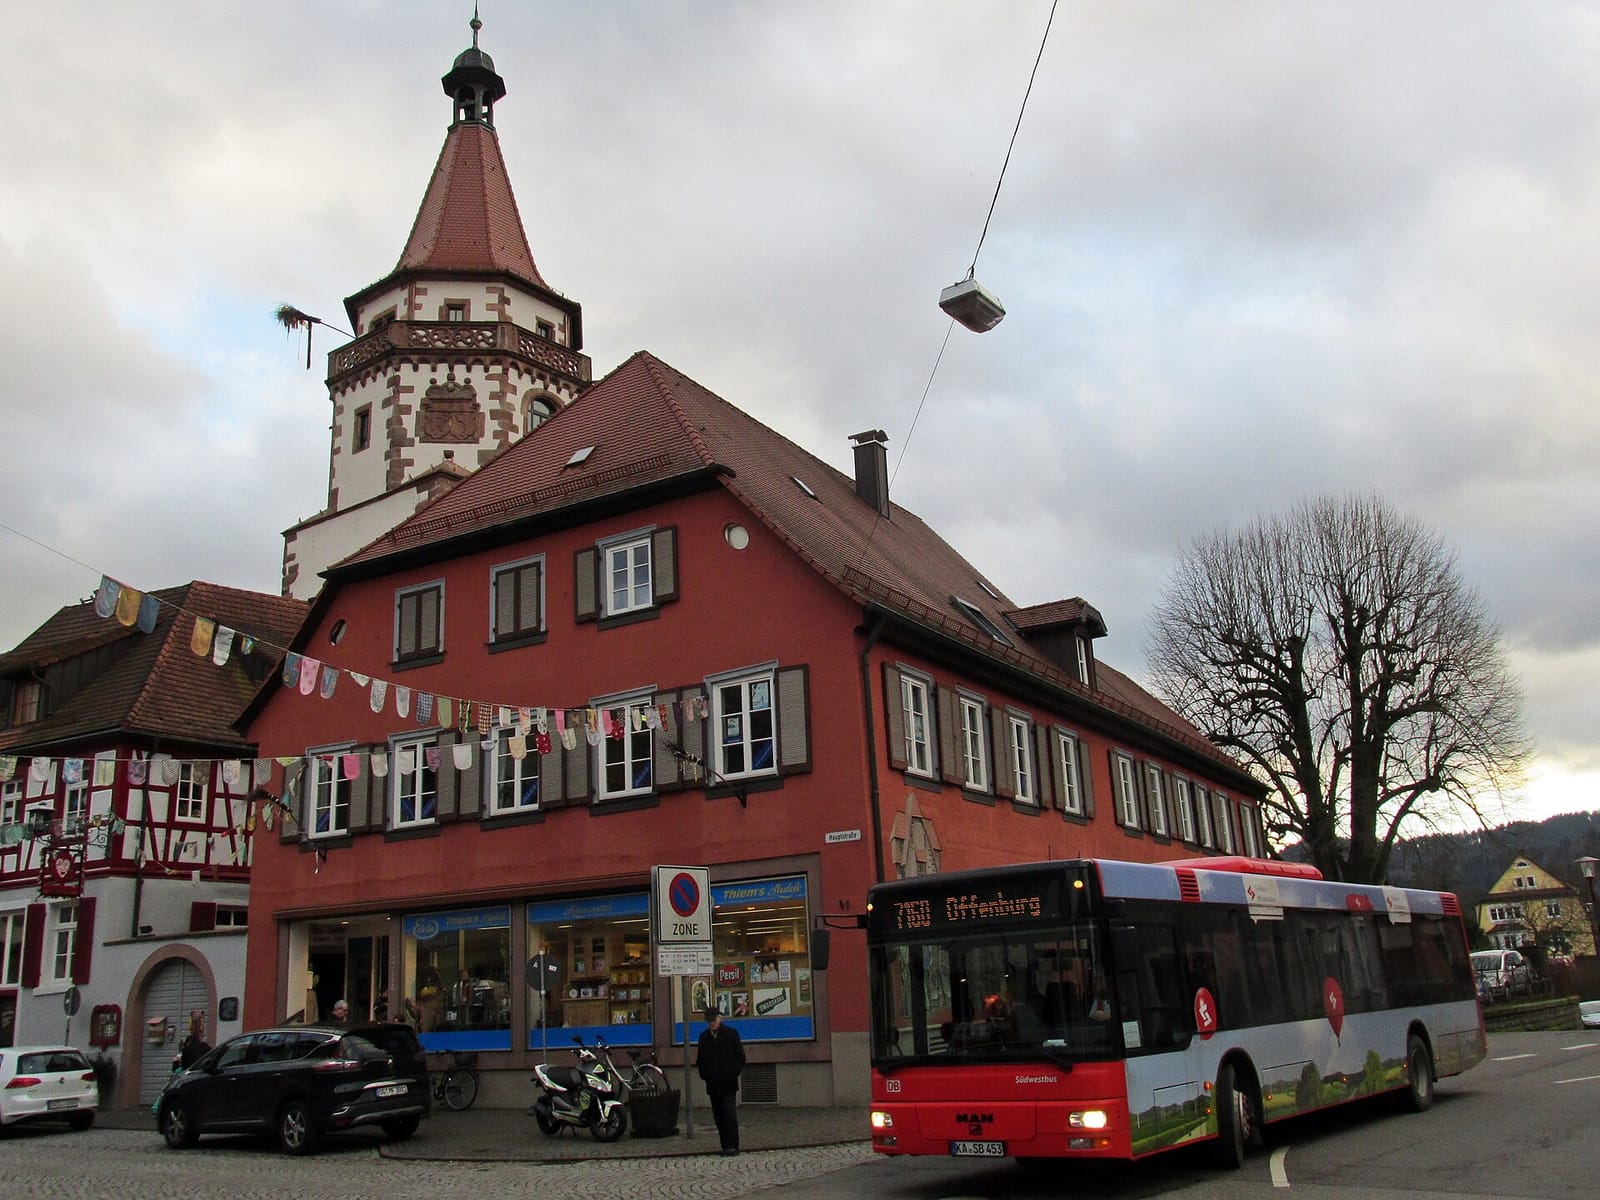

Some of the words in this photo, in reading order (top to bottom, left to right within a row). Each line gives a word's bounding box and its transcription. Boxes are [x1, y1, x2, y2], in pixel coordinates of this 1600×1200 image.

[723, 887, 766, 899] Thiem's
[946, 891, 1041, 920] Offenburg
[672, 923, 699, 936] ZONE
[719, 968, 740, 982] Persil
[1015, 1075, 1058, 1084] Südwestbus
[888, 1081, 900, 1092] DB
[956, 1113, 994, 1124] MAN
[956, 1142, 968, 1154] KA
[974, 1142, 985, 1155] SB
[986, 1142, 1003, 1155] 453
